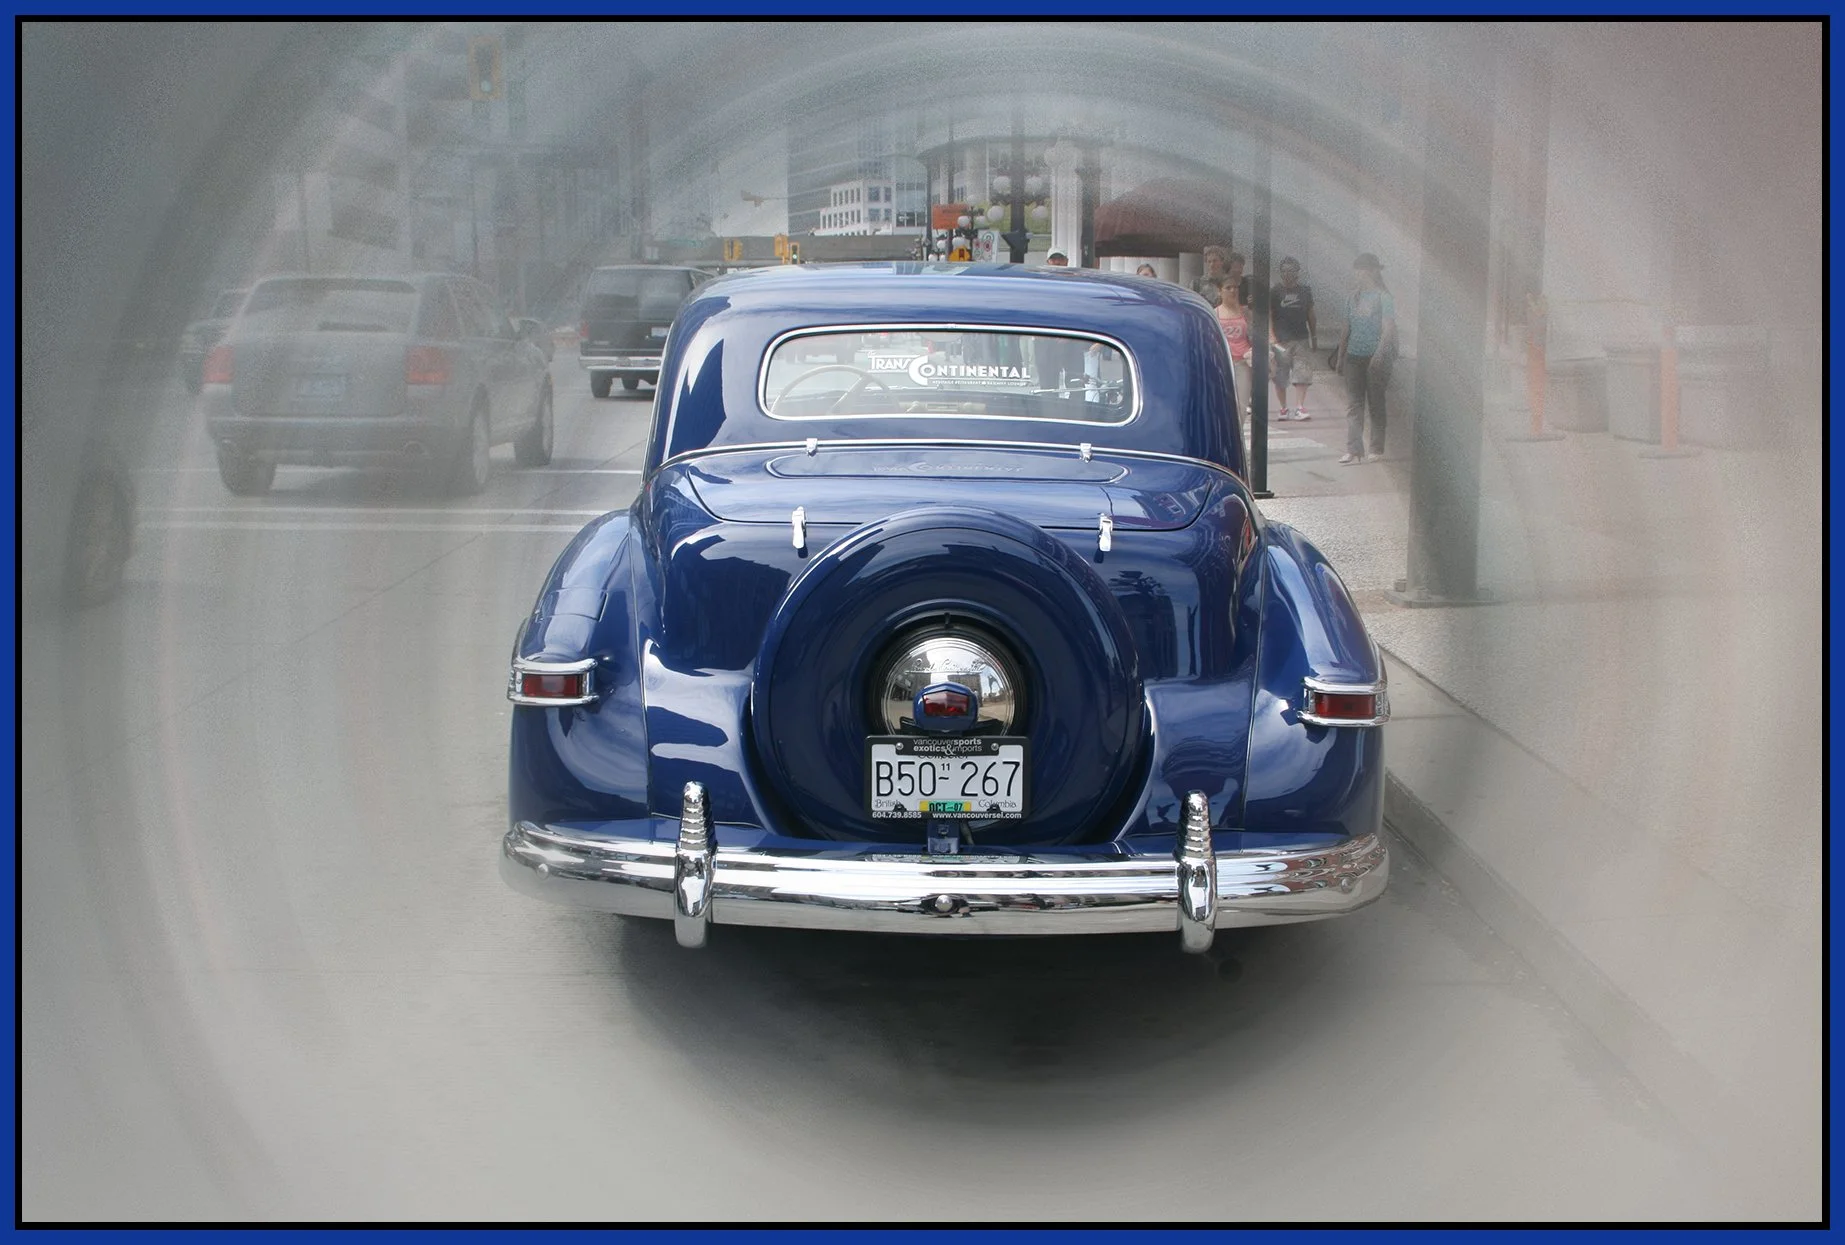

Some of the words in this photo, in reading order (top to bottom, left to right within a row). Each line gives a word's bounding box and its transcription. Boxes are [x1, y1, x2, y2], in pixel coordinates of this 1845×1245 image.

[909, 355, 1031, 386] CONTINENTAL
[872, 811, 922, 819] 604.739.8585
[932, 811, 1022, 819] www.vancouversel.com
